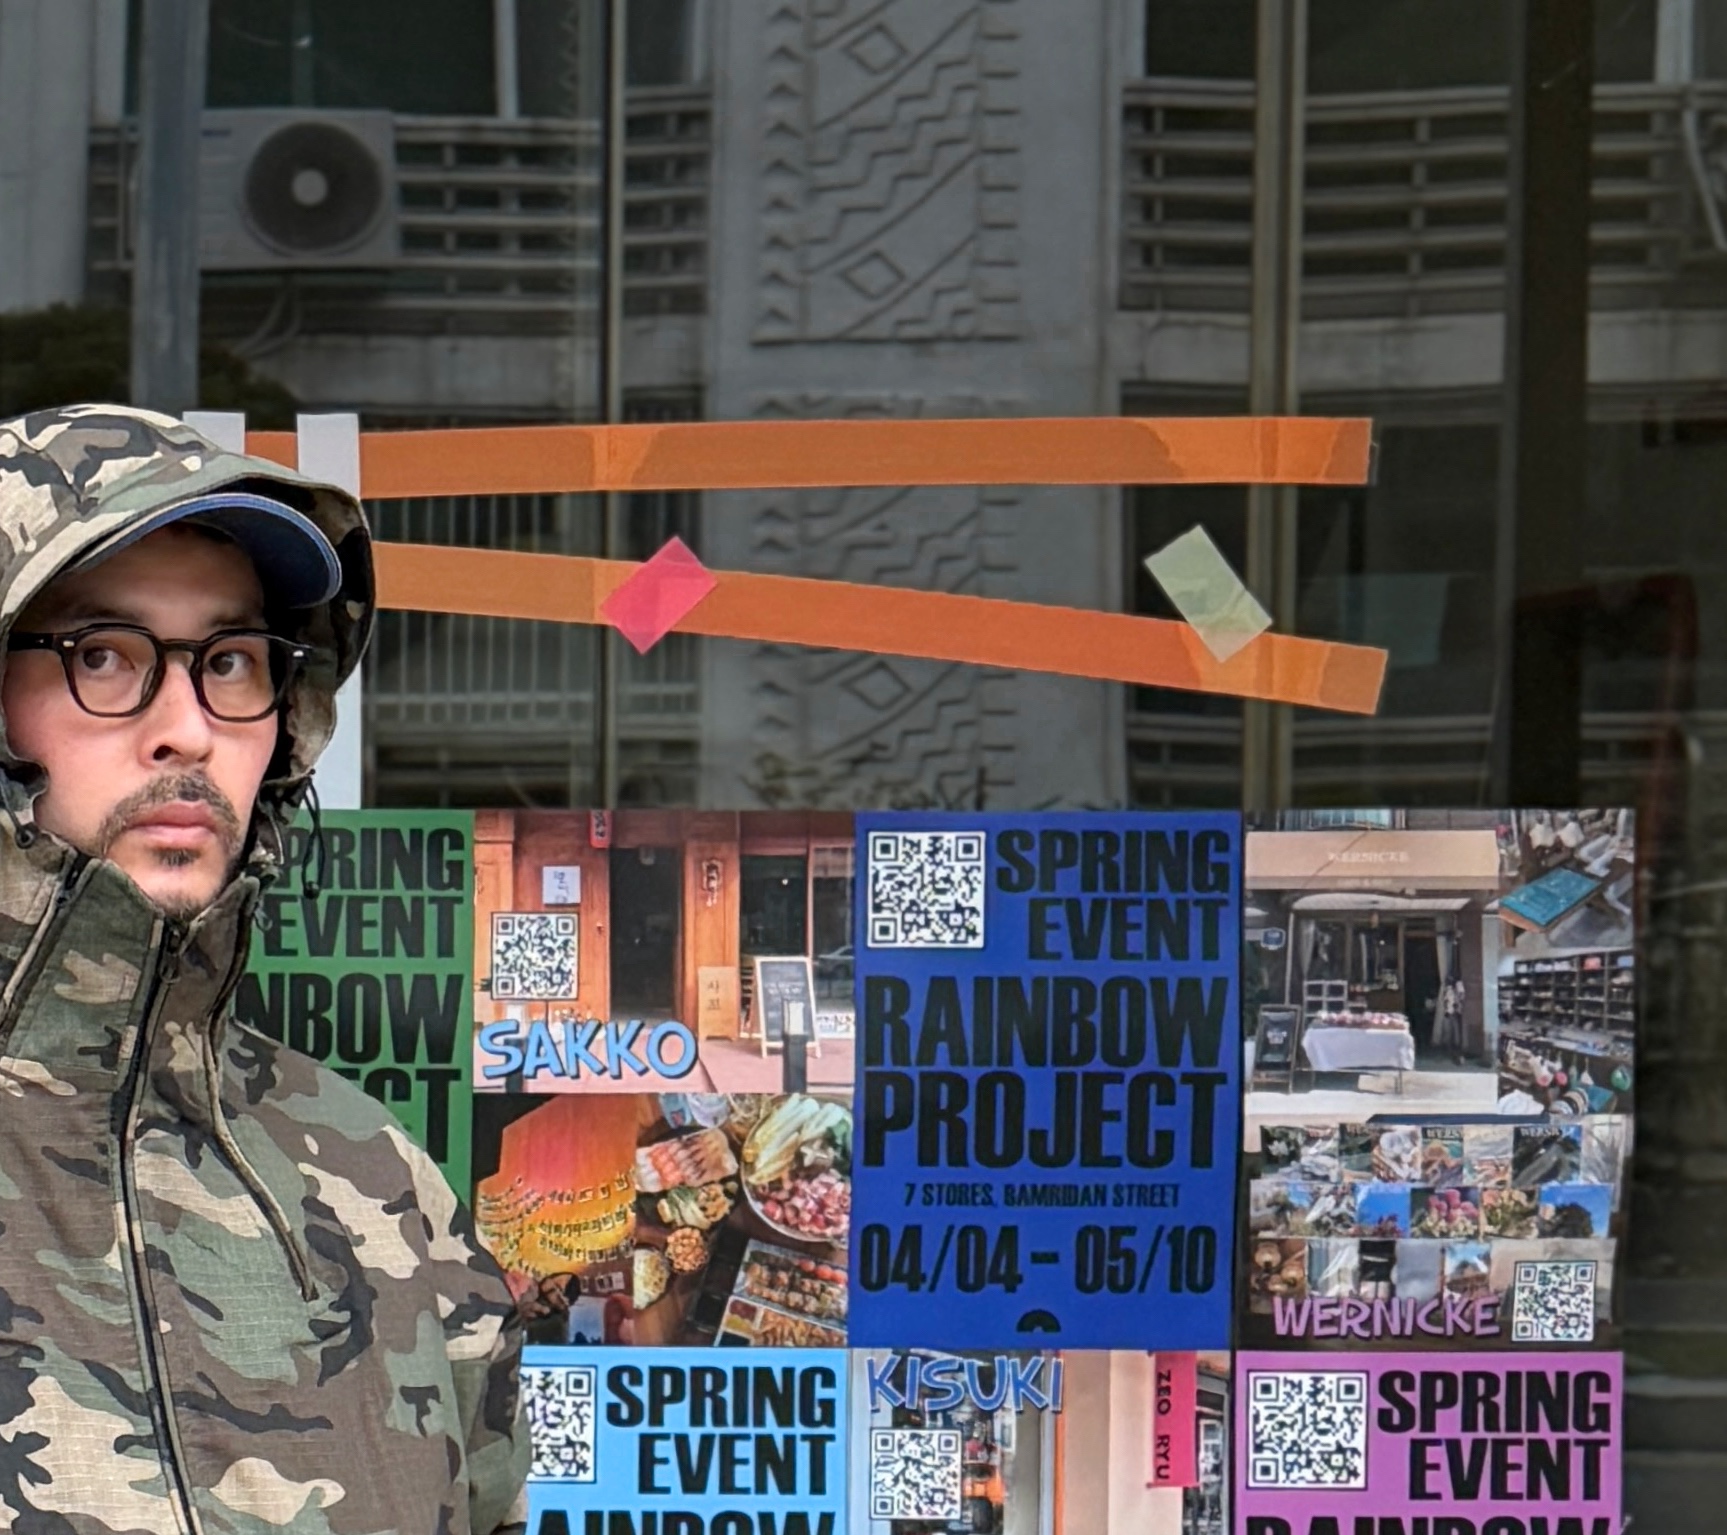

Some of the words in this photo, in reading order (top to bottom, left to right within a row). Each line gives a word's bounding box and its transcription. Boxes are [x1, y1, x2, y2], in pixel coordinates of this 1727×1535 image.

[274, 827, 465, 892] PRING
[996, 829, 1230, 893] SPRING
[264, 895, 464, 958] EVENT
[1028, 898, 1229, 961] EVENT
[235, 972, 465, 1064] NBOW
[478, 1018, 699, 1081] SAKKO
[864, 976, 1229, 1067] RAINBOW
[862, 1070, 1228, 1169] PROJECT
[904, 1183, 916, 1207] 7
[1004, 1183, 1106, 1208] BAMRIDAN
[1112, 1183, 1180, 1208] STREET
[1074, 1224, 1217, 1295] 05/10
[1271, 1295, 1501, 1340] WERNICKE
[606, 1364, 836, 1429] SPRING
[865, 1354, 1065, 1414] KISUKI
[1156, 1368, 1172, 1416] ZEO
[1377, 1370, 1611, 1434] SPRING
[638, 1433, 836, 1496] EVENT
[1156, 1434, 1172, 1480] RYU
[1408, 1438, 1610, 1500] EVENT
